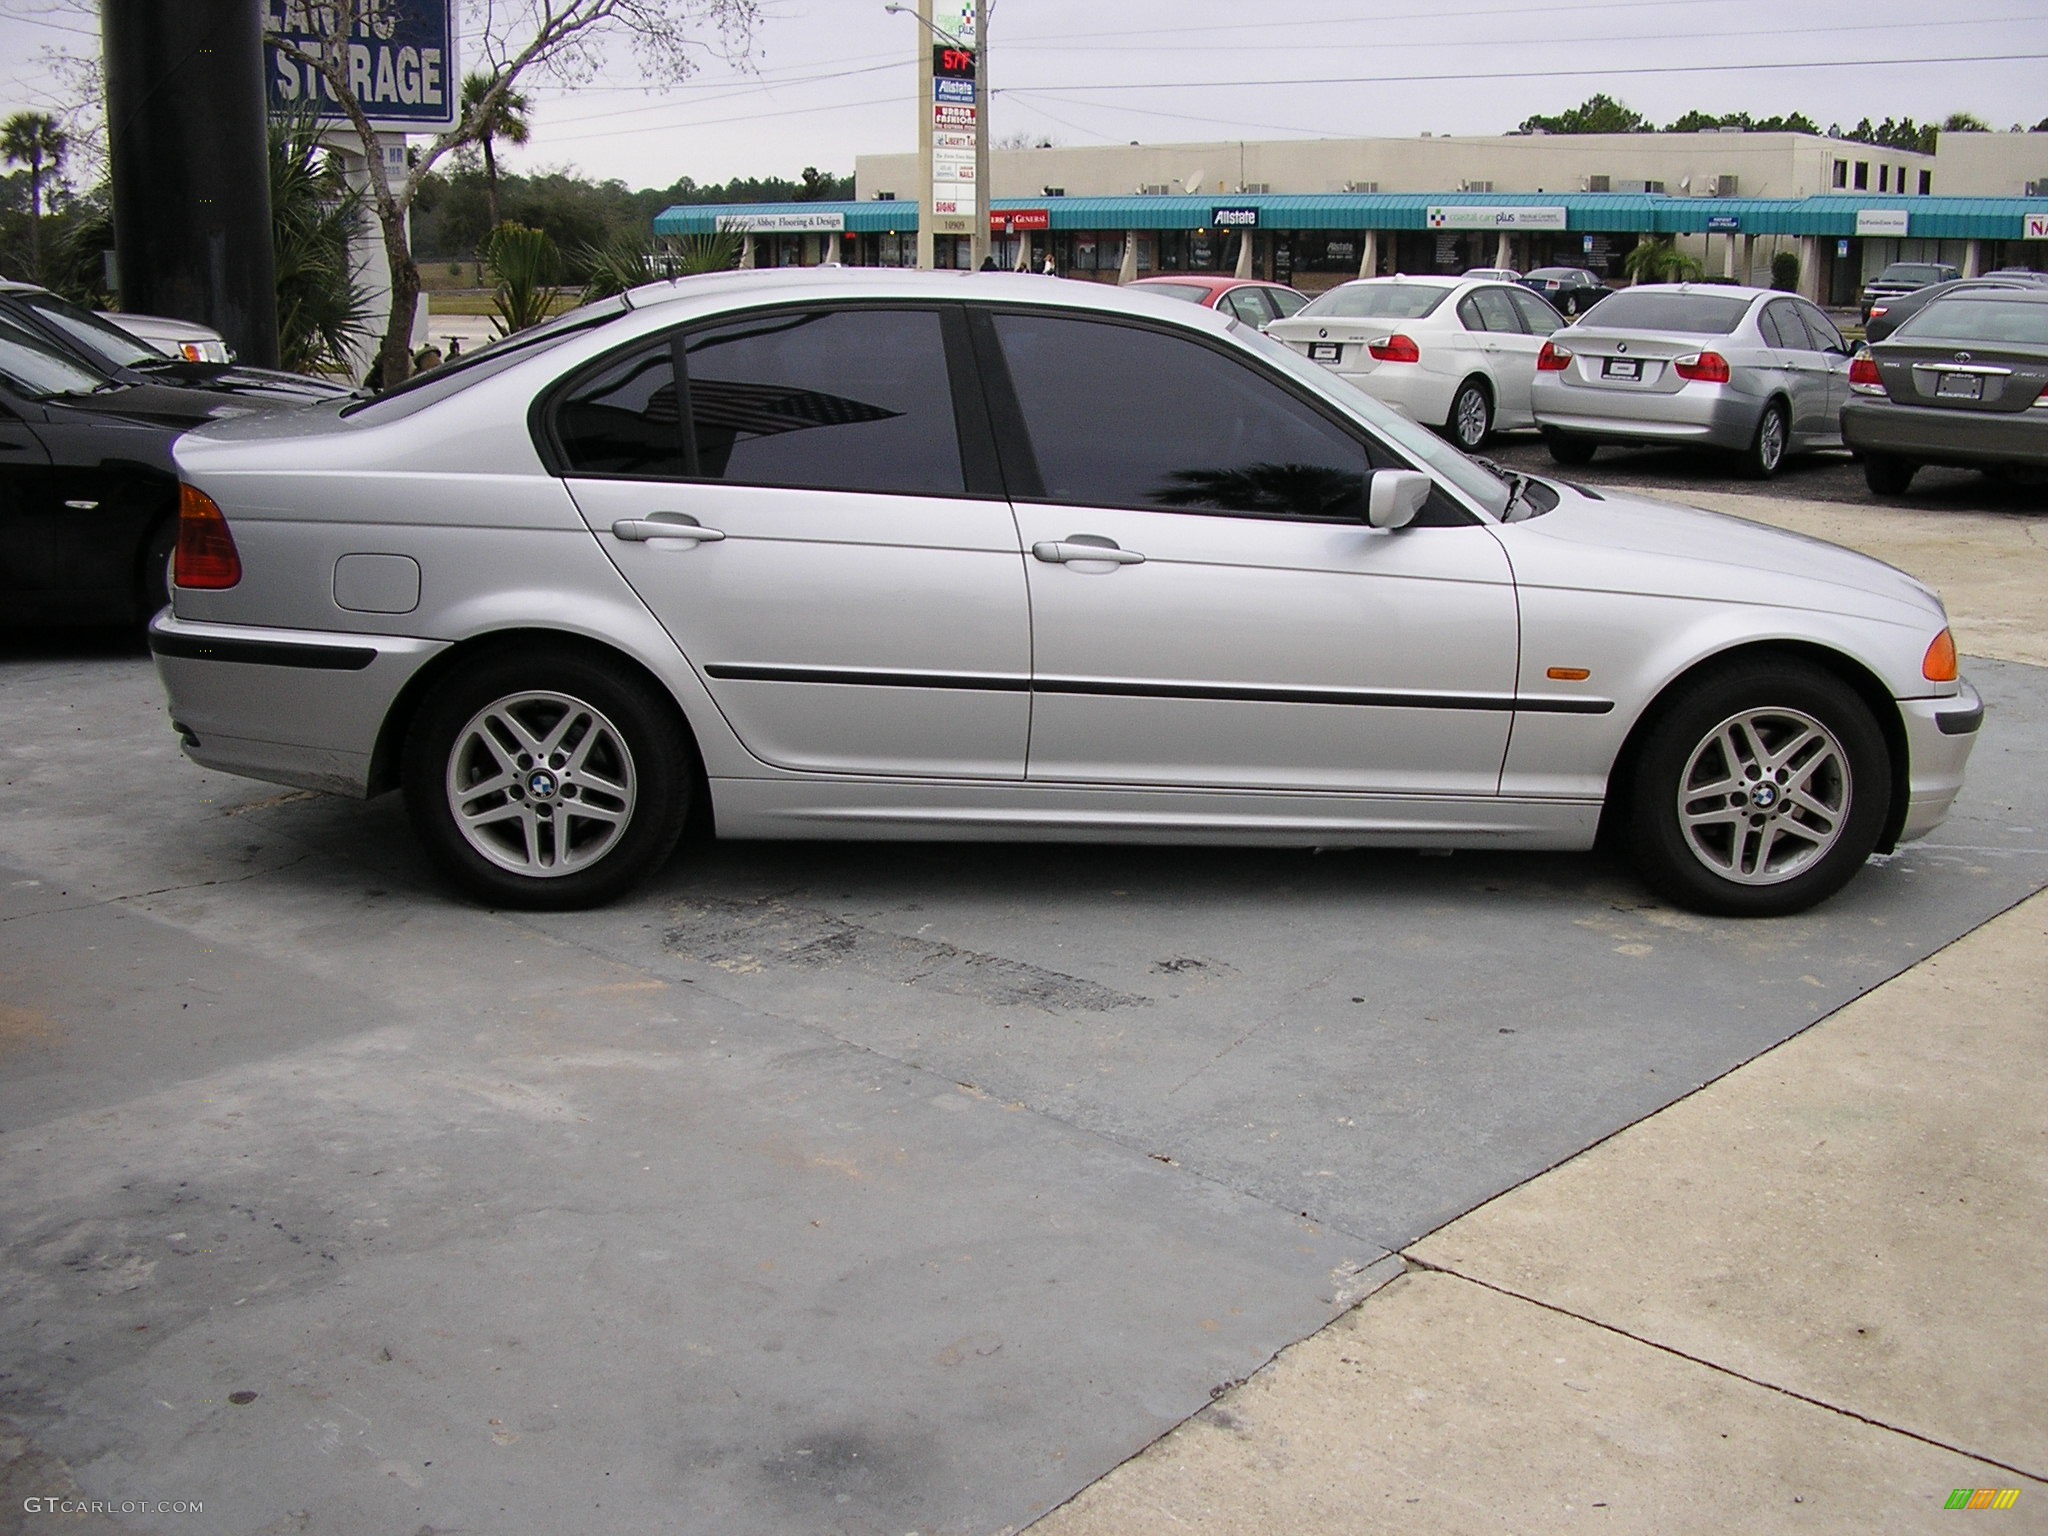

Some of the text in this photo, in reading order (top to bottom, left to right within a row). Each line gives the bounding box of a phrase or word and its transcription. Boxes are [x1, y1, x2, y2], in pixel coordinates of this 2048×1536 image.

[262, 0, 396, 40] LANIC
[277, 39, 443, 105] STORAGE
[938, 80, 973, 95] Allstate
[935, 202, 956, 213] SIGNS
[779, 215, 808, 228] Flooring
[816, 214, 841, 228] Design
[1214, 210, 1256, 225] Allstate
[944, 221, 965, 230] 10909
